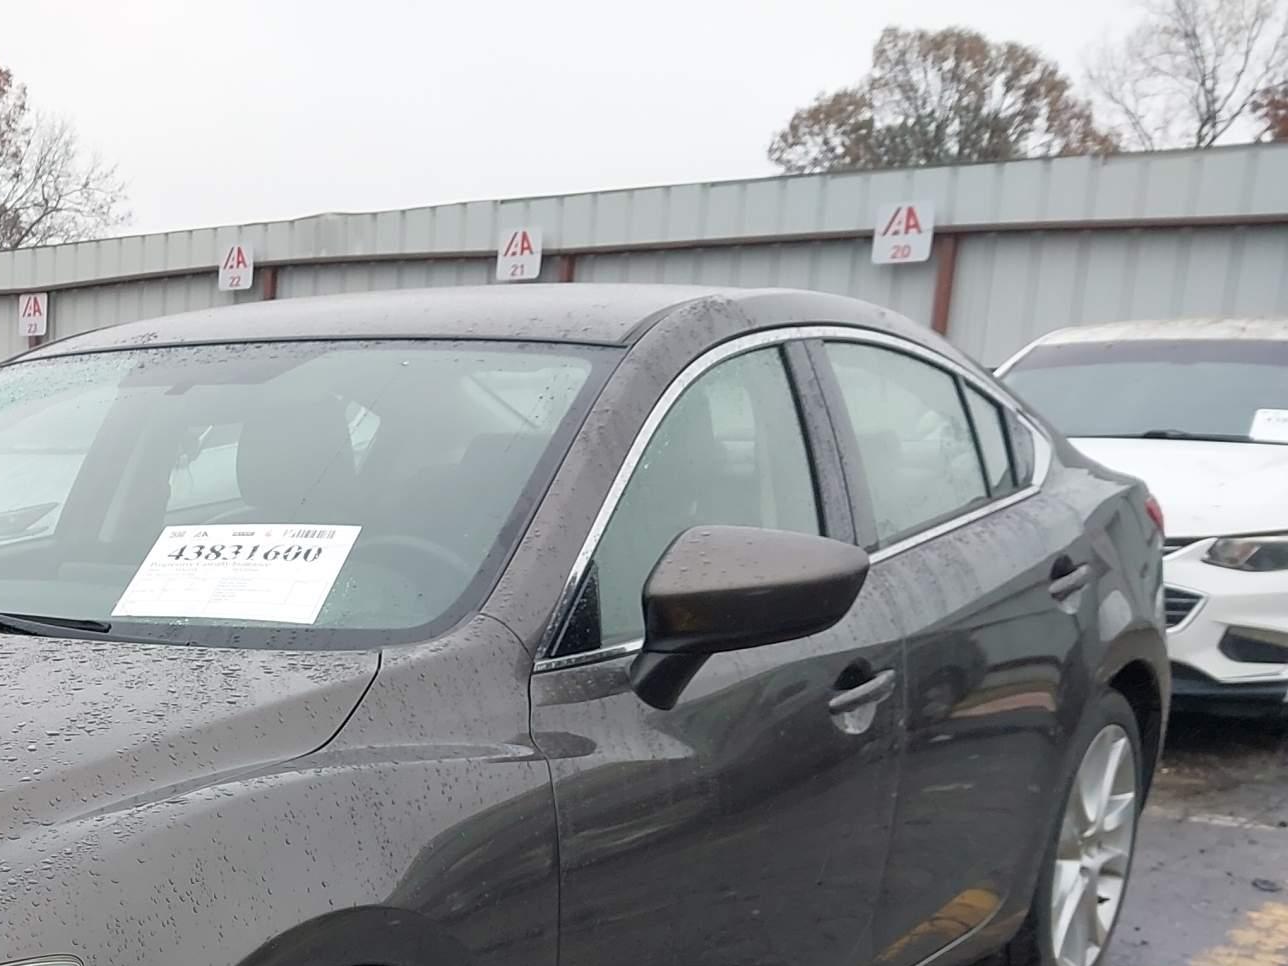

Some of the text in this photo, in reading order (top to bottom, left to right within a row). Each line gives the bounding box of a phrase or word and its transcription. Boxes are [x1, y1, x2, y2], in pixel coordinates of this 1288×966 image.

[890, 244, 912, 259] 20
[509, 263, 525, 277] 21
[228, 275, 241, 288] 22
[27, 322, 39, 334] 23
[168, 544, 323, 563] 43831600
